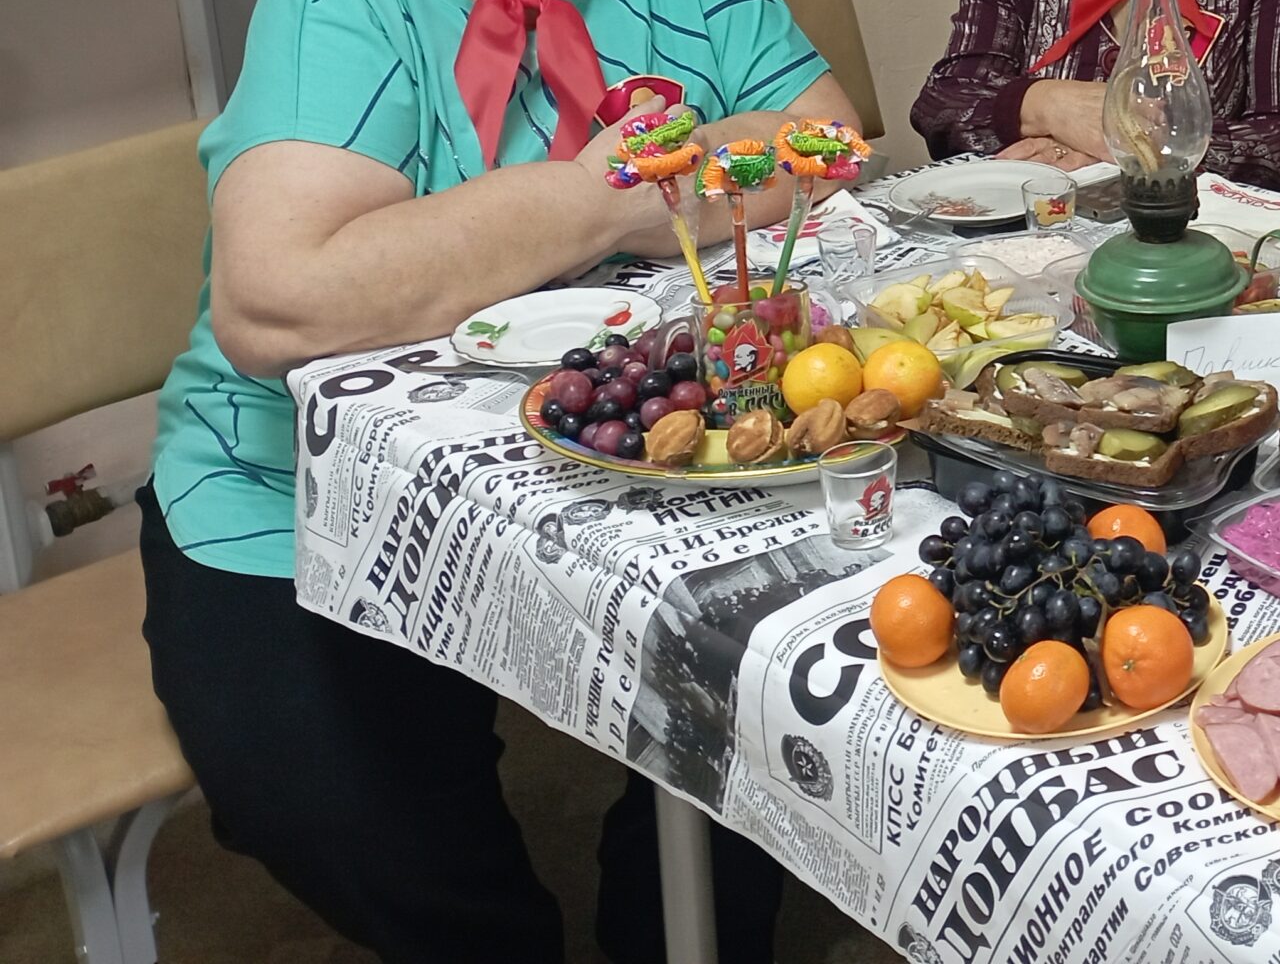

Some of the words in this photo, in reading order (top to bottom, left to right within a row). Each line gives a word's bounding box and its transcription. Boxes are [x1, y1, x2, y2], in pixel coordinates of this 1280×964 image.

[350, 475, 364, 538] КПСС
[361, 407, 414, 466] Борбор
[649, 542, 679, 559] Л.
[680, 534, 714, 551] И.
[714, 508, 814, 541] Брежн
[470, 544, 493, 609] партии
[887, 764, 905, 847] КПСС
[896, 713, 931, 752] Бо
[1172, 807, 1264, 834] Коми
